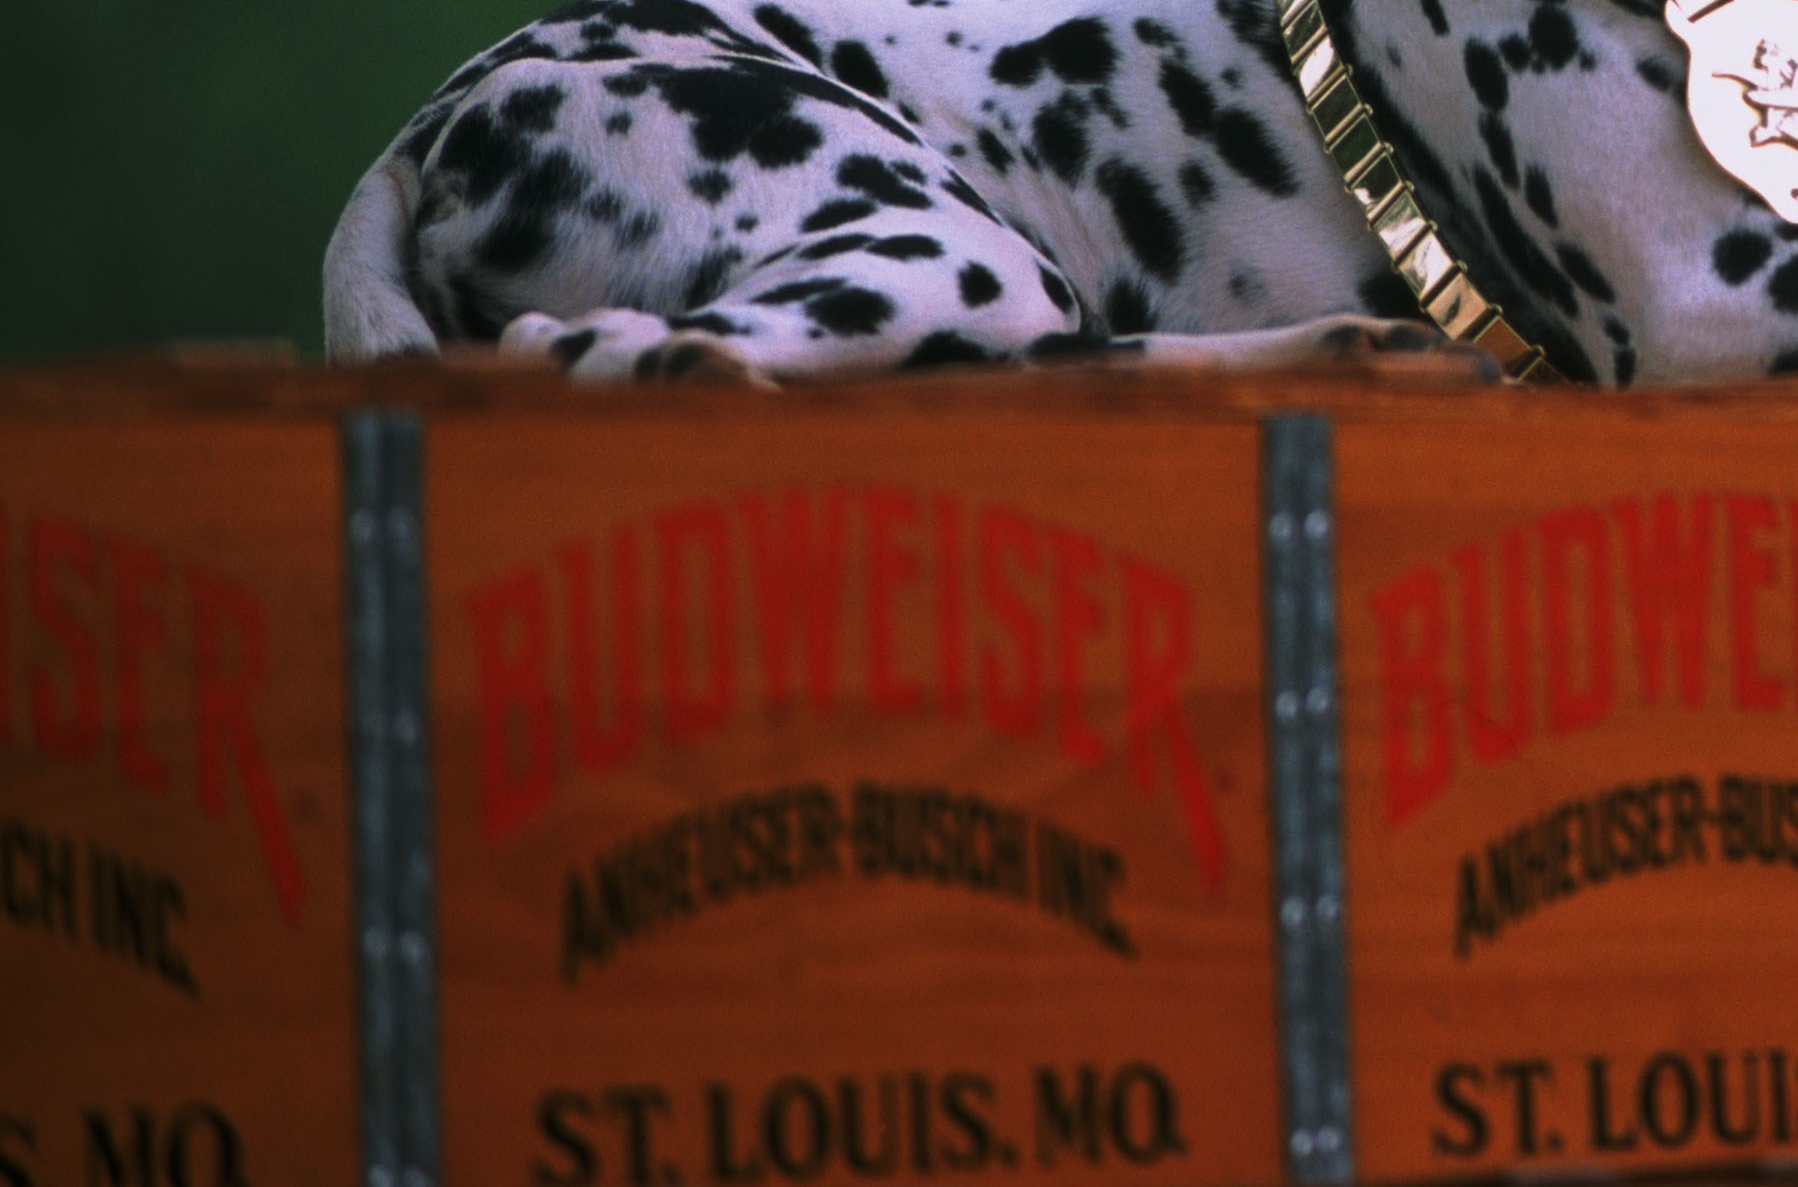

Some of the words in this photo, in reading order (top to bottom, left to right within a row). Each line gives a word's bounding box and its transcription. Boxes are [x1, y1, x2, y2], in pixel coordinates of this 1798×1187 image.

[461, 484, 1228, 891] BUDWEISER
[557, 779, 1028, 987] ANHEUSER-BUSCH
[532, 1085, 681, 1187] ST.
[1431, 1057, 1562, 1156] ST.
